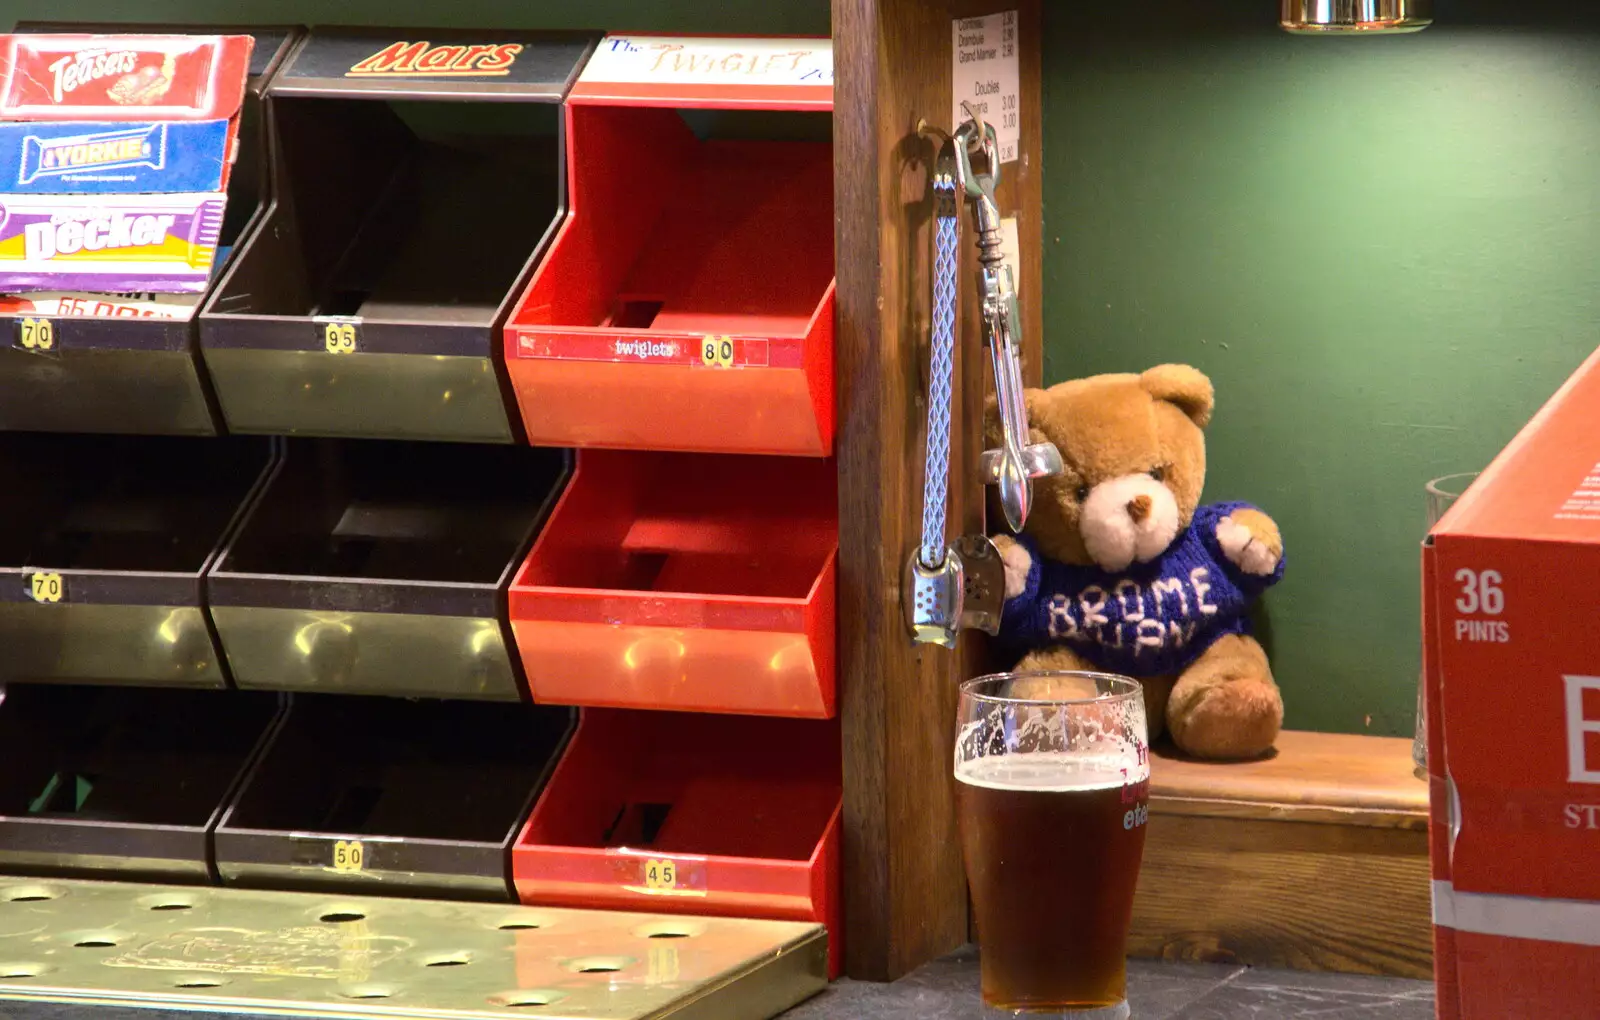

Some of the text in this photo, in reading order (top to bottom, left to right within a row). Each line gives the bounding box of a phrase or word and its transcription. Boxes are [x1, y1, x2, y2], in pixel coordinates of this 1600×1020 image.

[348, 40, 524, 72] Mars
[48, 50, 138, 103] Teasers
[975, 81, 1000, 96] Doubles
[1002, 94, 1016, 110] 3.00
[1003, 113, 1017, 129] 3.00
[55, 137, 143, 167] YORKIE
[24, 209, 176, 262] Decker
[24, 326, 49, 342] 70
[328, 332, 354, 348] 95
[615, 340, 675, 359] twiglets
[34, 579, 60, 595] 70
[1455, 568, 1504, 615] 36
[1455, 619, 1509, 643] PINTS
[337, 847, 361, 865] 50
[648, 866, 674, 884] 45
